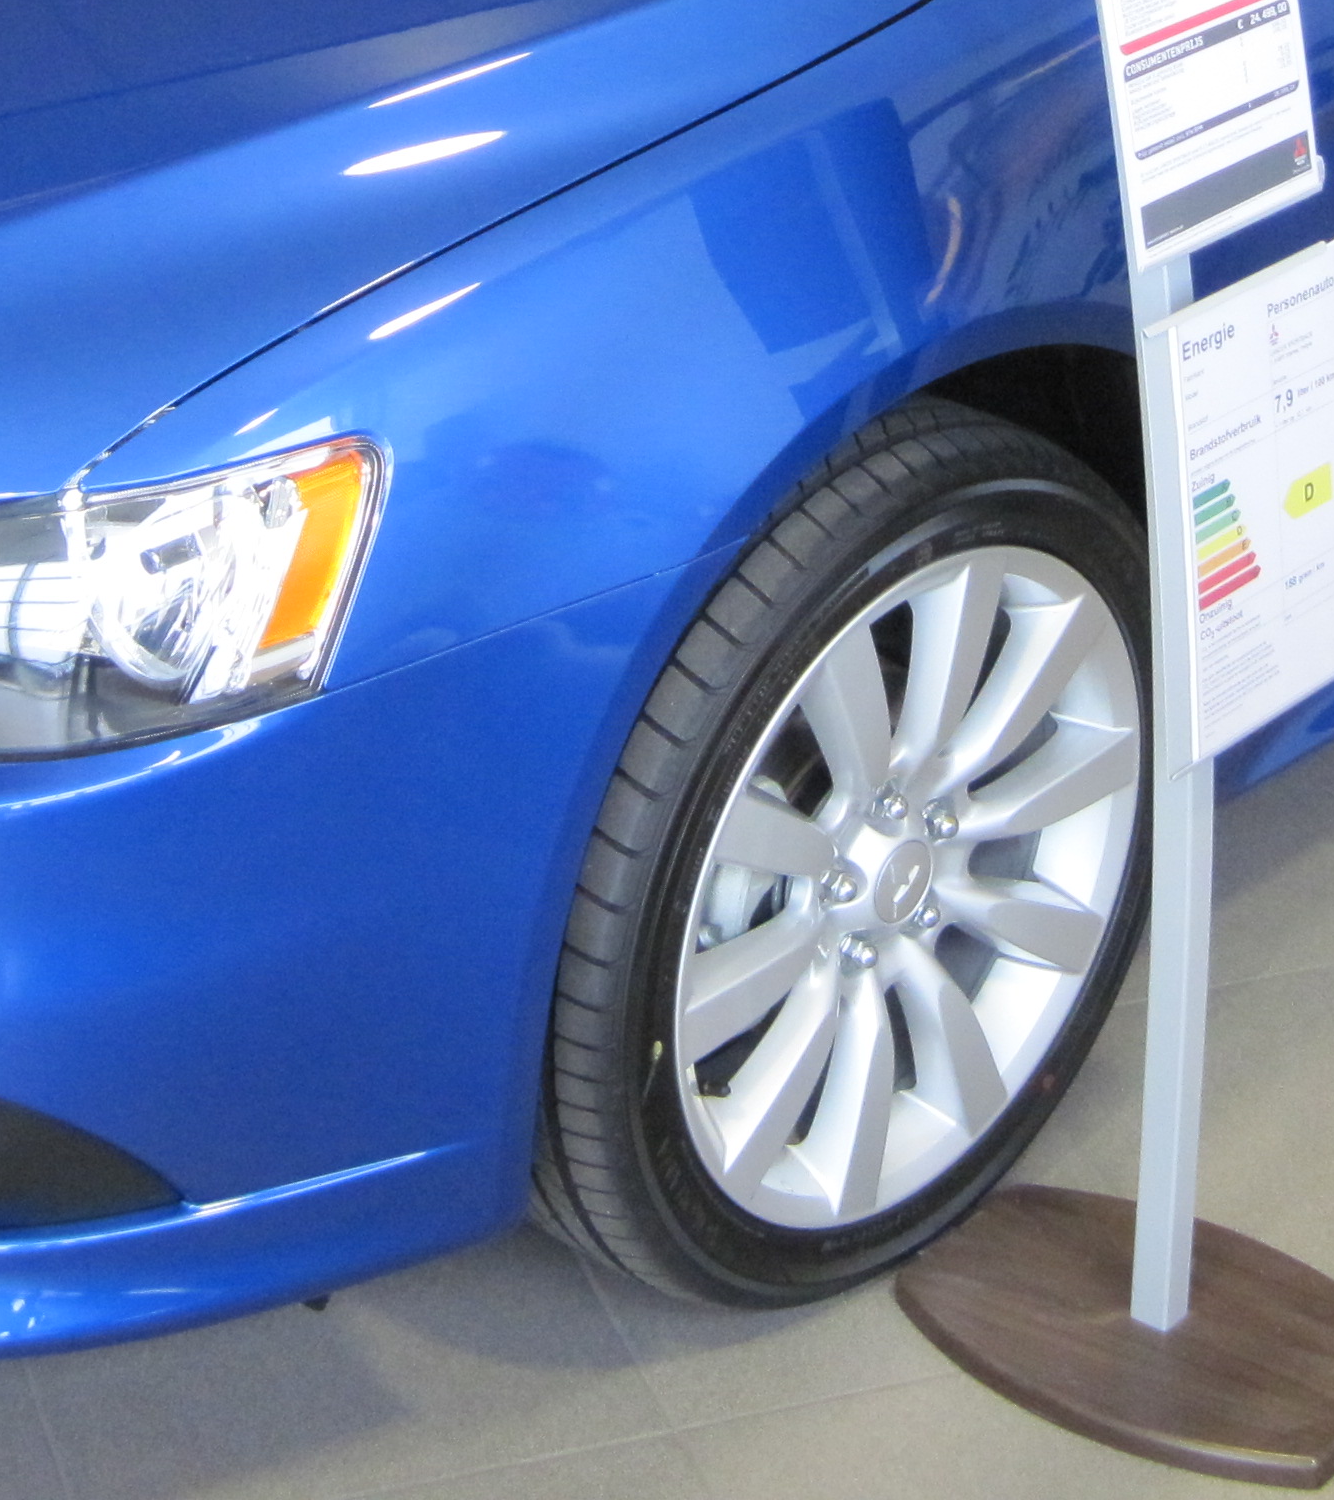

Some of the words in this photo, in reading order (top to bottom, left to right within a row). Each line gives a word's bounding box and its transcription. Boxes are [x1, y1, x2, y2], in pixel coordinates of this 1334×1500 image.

[1125, 35, 1204, 77] CONSUMENTENPRIJS
[1267, 275, 1334, 317] Personenauto
[1182, 322, 1235, 361] Energie
[1274, 388, 1294, 414] 7,9
[1189, 414, 1262, 461] Brandstofverbruik
[1191, 473, 1216, 492] Zuinig
[1304, 482, 1314, 503] D
[1198, 598, 1233, 624] Onzuinig
